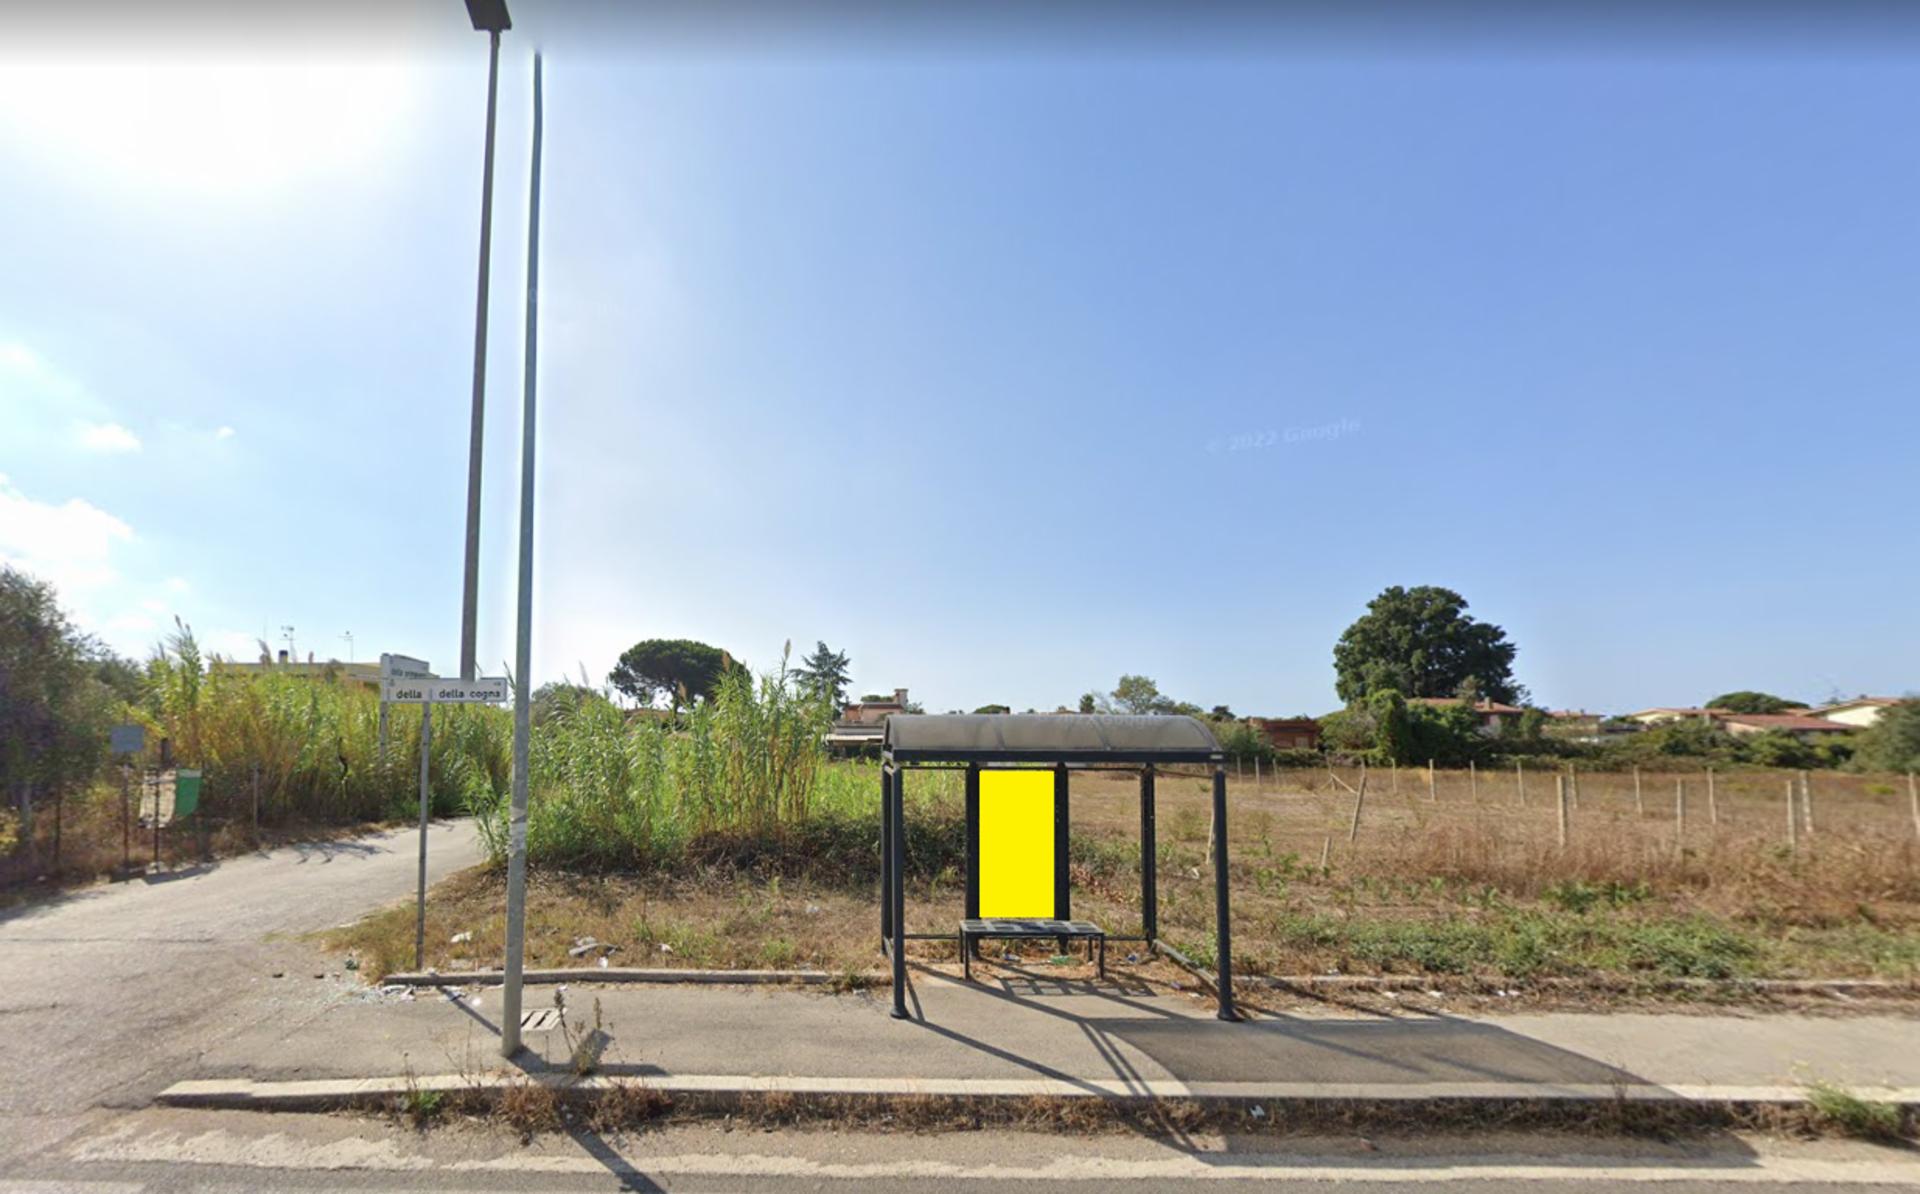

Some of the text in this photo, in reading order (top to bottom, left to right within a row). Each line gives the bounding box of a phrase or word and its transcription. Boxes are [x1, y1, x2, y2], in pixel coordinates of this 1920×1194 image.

[396, 689, 500, 701] della della cogna
